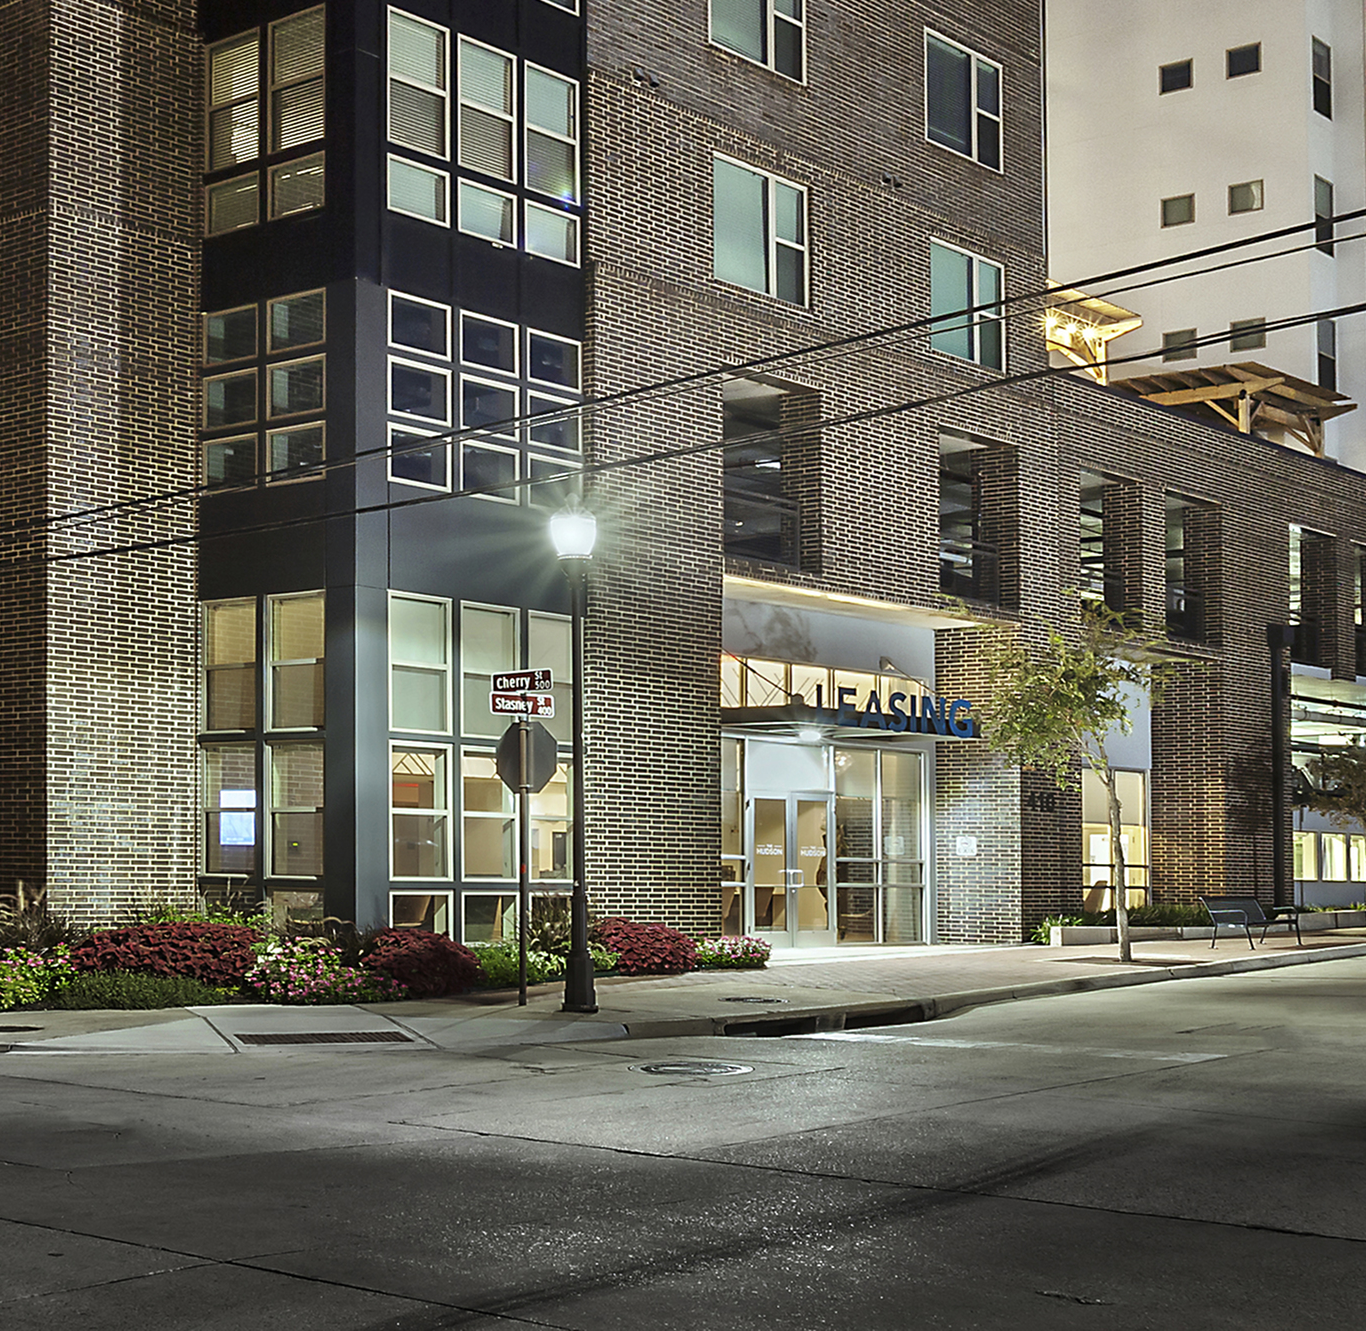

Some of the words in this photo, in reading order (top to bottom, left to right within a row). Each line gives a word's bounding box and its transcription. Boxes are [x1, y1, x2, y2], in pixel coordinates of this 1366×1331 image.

[496, 676, 531, 690] Cherry
[535, 671, 543, 680] St
[535, 680, 551, 690] 500
[495, 697, 534, 714] Stasney
[537, 696, 546, 706] St
[816, 683, 974, 739] LEASING
